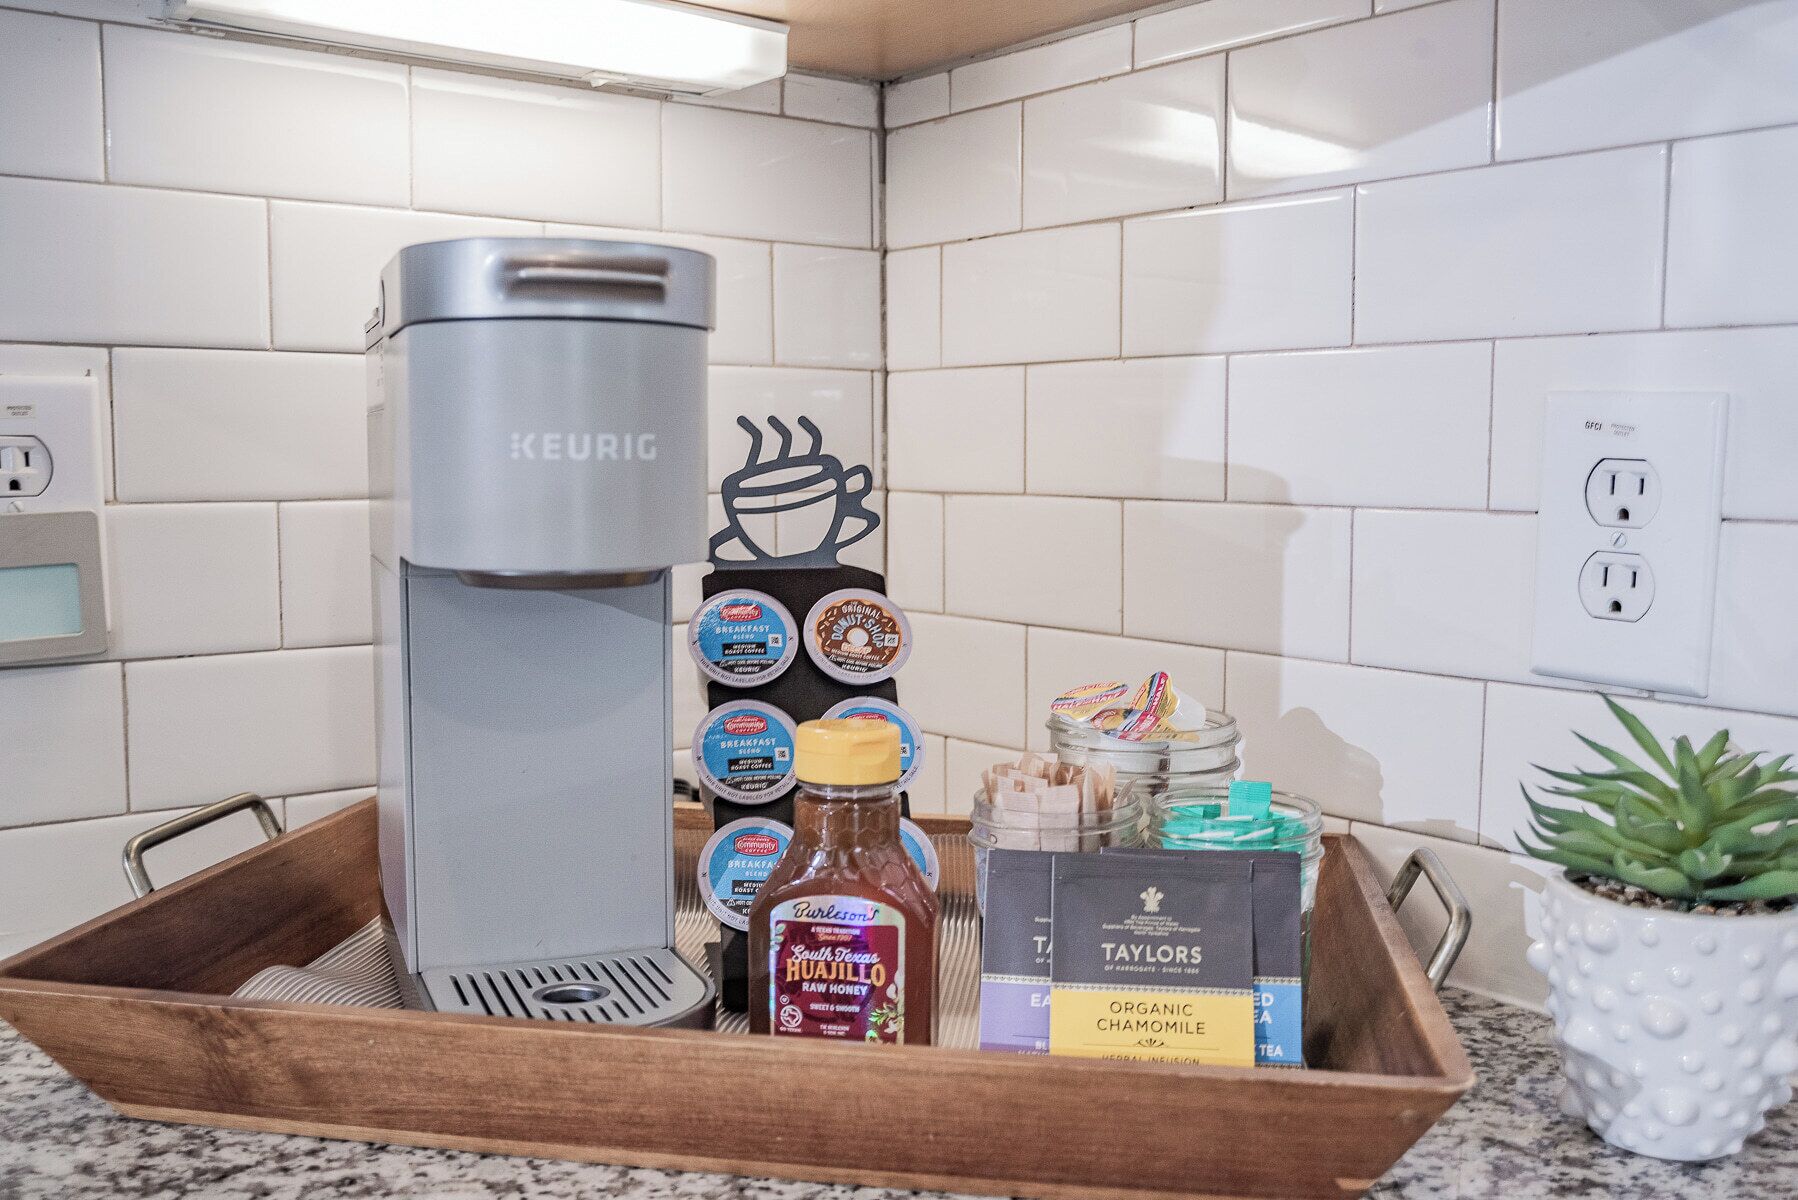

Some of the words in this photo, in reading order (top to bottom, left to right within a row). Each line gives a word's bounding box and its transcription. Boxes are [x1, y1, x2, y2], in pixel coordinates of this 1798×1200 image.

[1584, 421, 1602, 431] GFCI
[510, 432, 657, 461] KEURIG
[841, 604, 881, 620] ORIGINAL
[715, 624, 770, 634] BREAKFAST
[831, 614, 864, 641] DONUT
[864, 618, 885, 648] SHOP
[734, 665, 762, 673] KEURIG
[841, 663, 869, 673] KEURIG
[720, 737, 777, 749] BREAKFAST
[740, 782, 769, 790] KEURIG
[737, 841, 776, 851] Community
[727, 860, 777, 869] BREAKFA
[793, 901, 880, 921] Burleson's
[791, 944, 834, 963] South
[834, 946, 881, 964] Texas
[1101, 942, 1202, 964] TAYLORS
[786, 958, 886, 987] HUAJILLO
[1115, 965, 1156, 973] HARROGATE
[1161, 966, 1182, 974] SINCE
[802, 982, 827, 993] RAW
[829, 983, 868, 996] HONEY
[809, 1002, 830, 1011] SWEET
[1030, 993, 1051, 1008] EA
[1109, 1001, 1193, 1017] ORGANIC
[1096, 1018, 1206, 1035] CHAMOMILE
[1259, 1043, 1284, 1057] TEA
